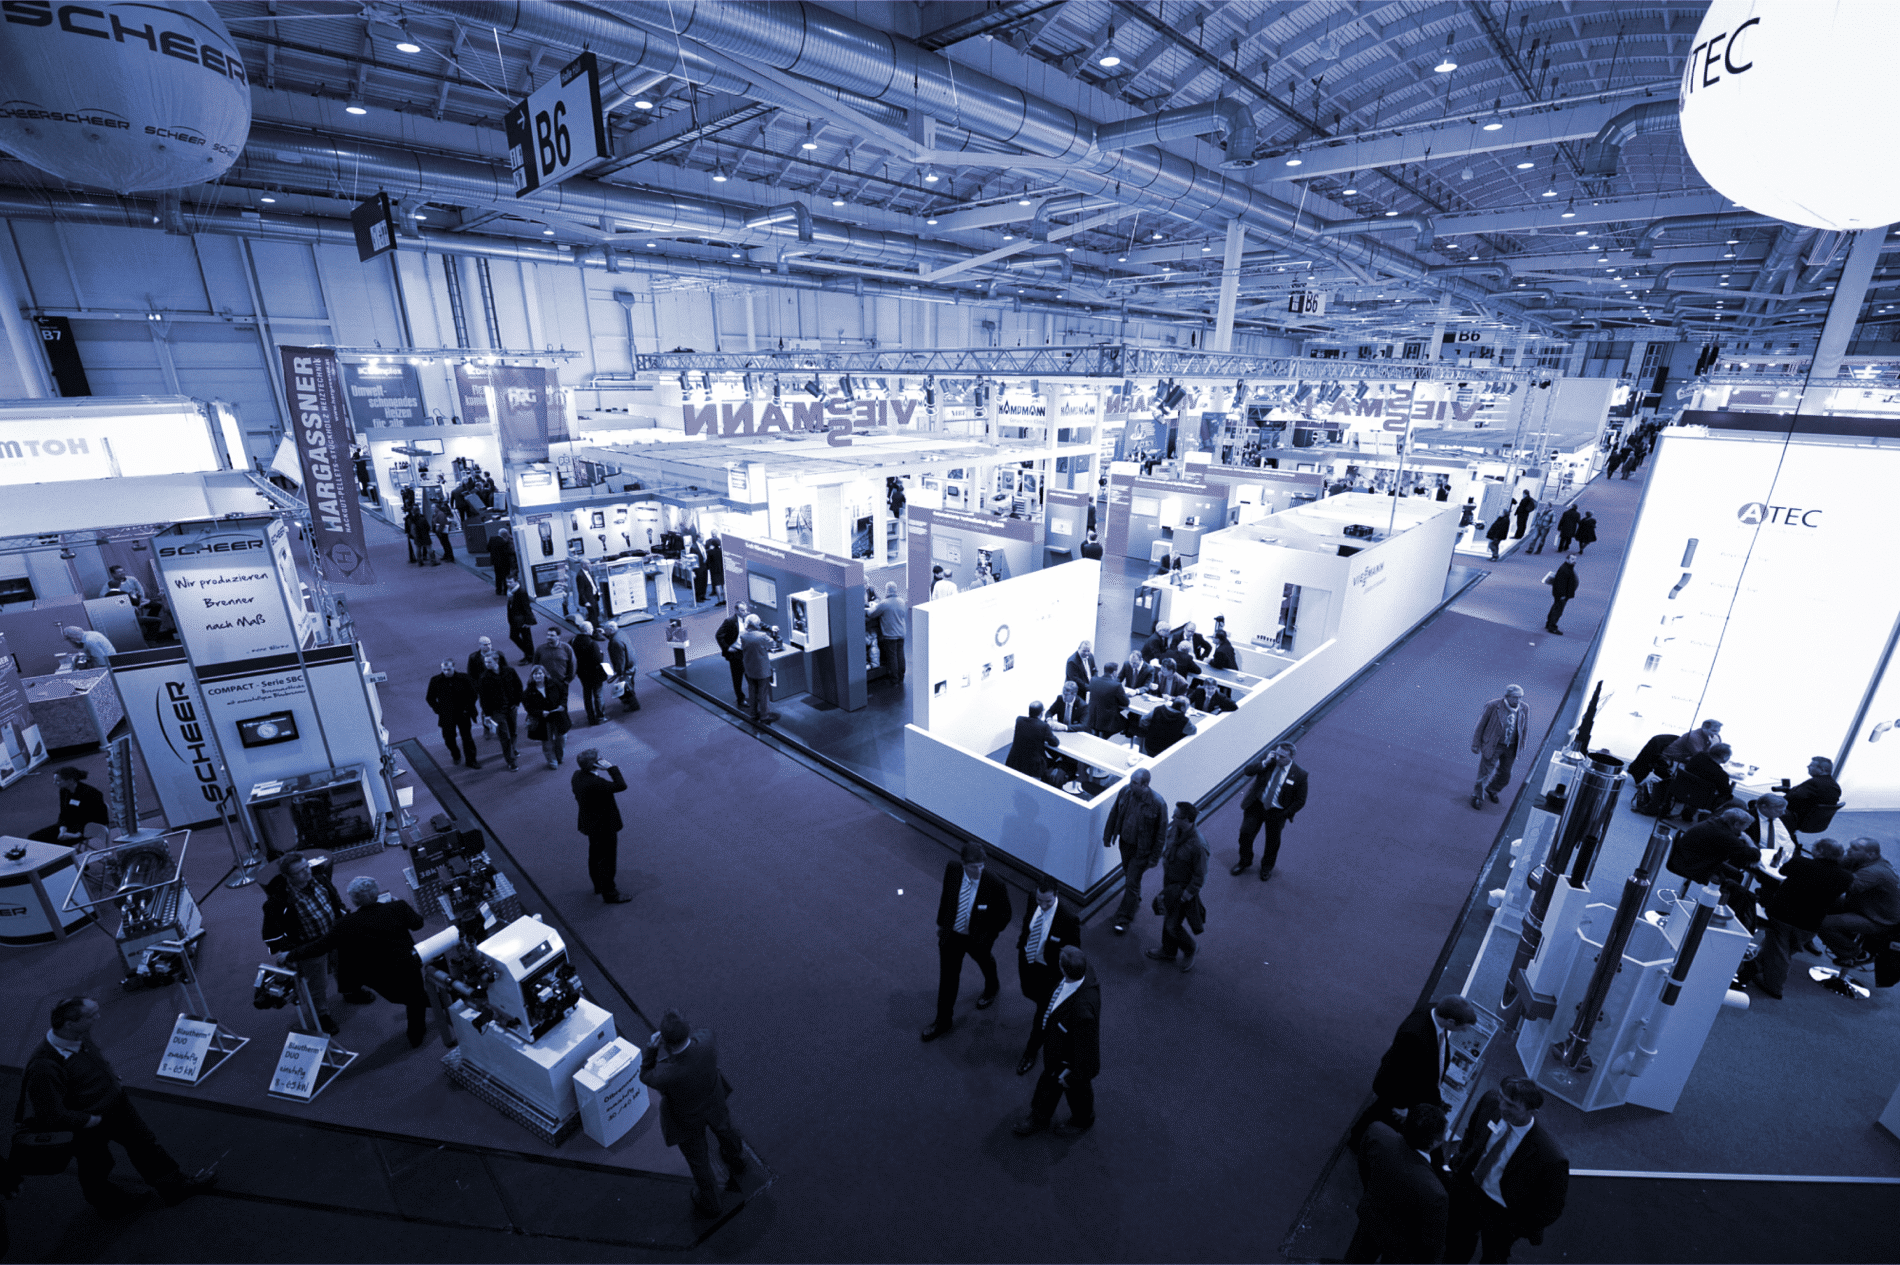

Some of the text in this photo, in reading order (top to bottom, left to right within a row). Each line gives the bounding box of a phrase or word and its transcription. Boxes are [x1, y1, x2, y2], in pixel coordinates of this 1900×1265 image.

[3, 0, 247, 86] SCHEER
[144, 125, 206, 146] SCHEER
[535, 101, 571, 177] B6
[1305, 293, 1319, 313] B6
[42, 330, 61, 340] B7
[1458, 331, 1481, 342] B6
[293, 356, 343, 532] HARGASSNER
[1737, 502, 1822, 528] ATEC
[160, 539, 264, 557] SCHEER
[174, 573, 268, 589] Wir produzieren
[203, 597, 254, 608] Brenner
[206, 613, 266, 631] nach Maß
[208, 683, 254, 696] COMPACT
[261, 678, 285, 688] Serie
[286, 675, 304, 684] SBC
[165, 681, 224, 803] SCHEER
[173, 1036, 187, 1045] DUO
[284, 1051, 299, 1059] DUO
[184, 1065, 196, 1077] kW
[297, 1081, 310, 1093] kW
